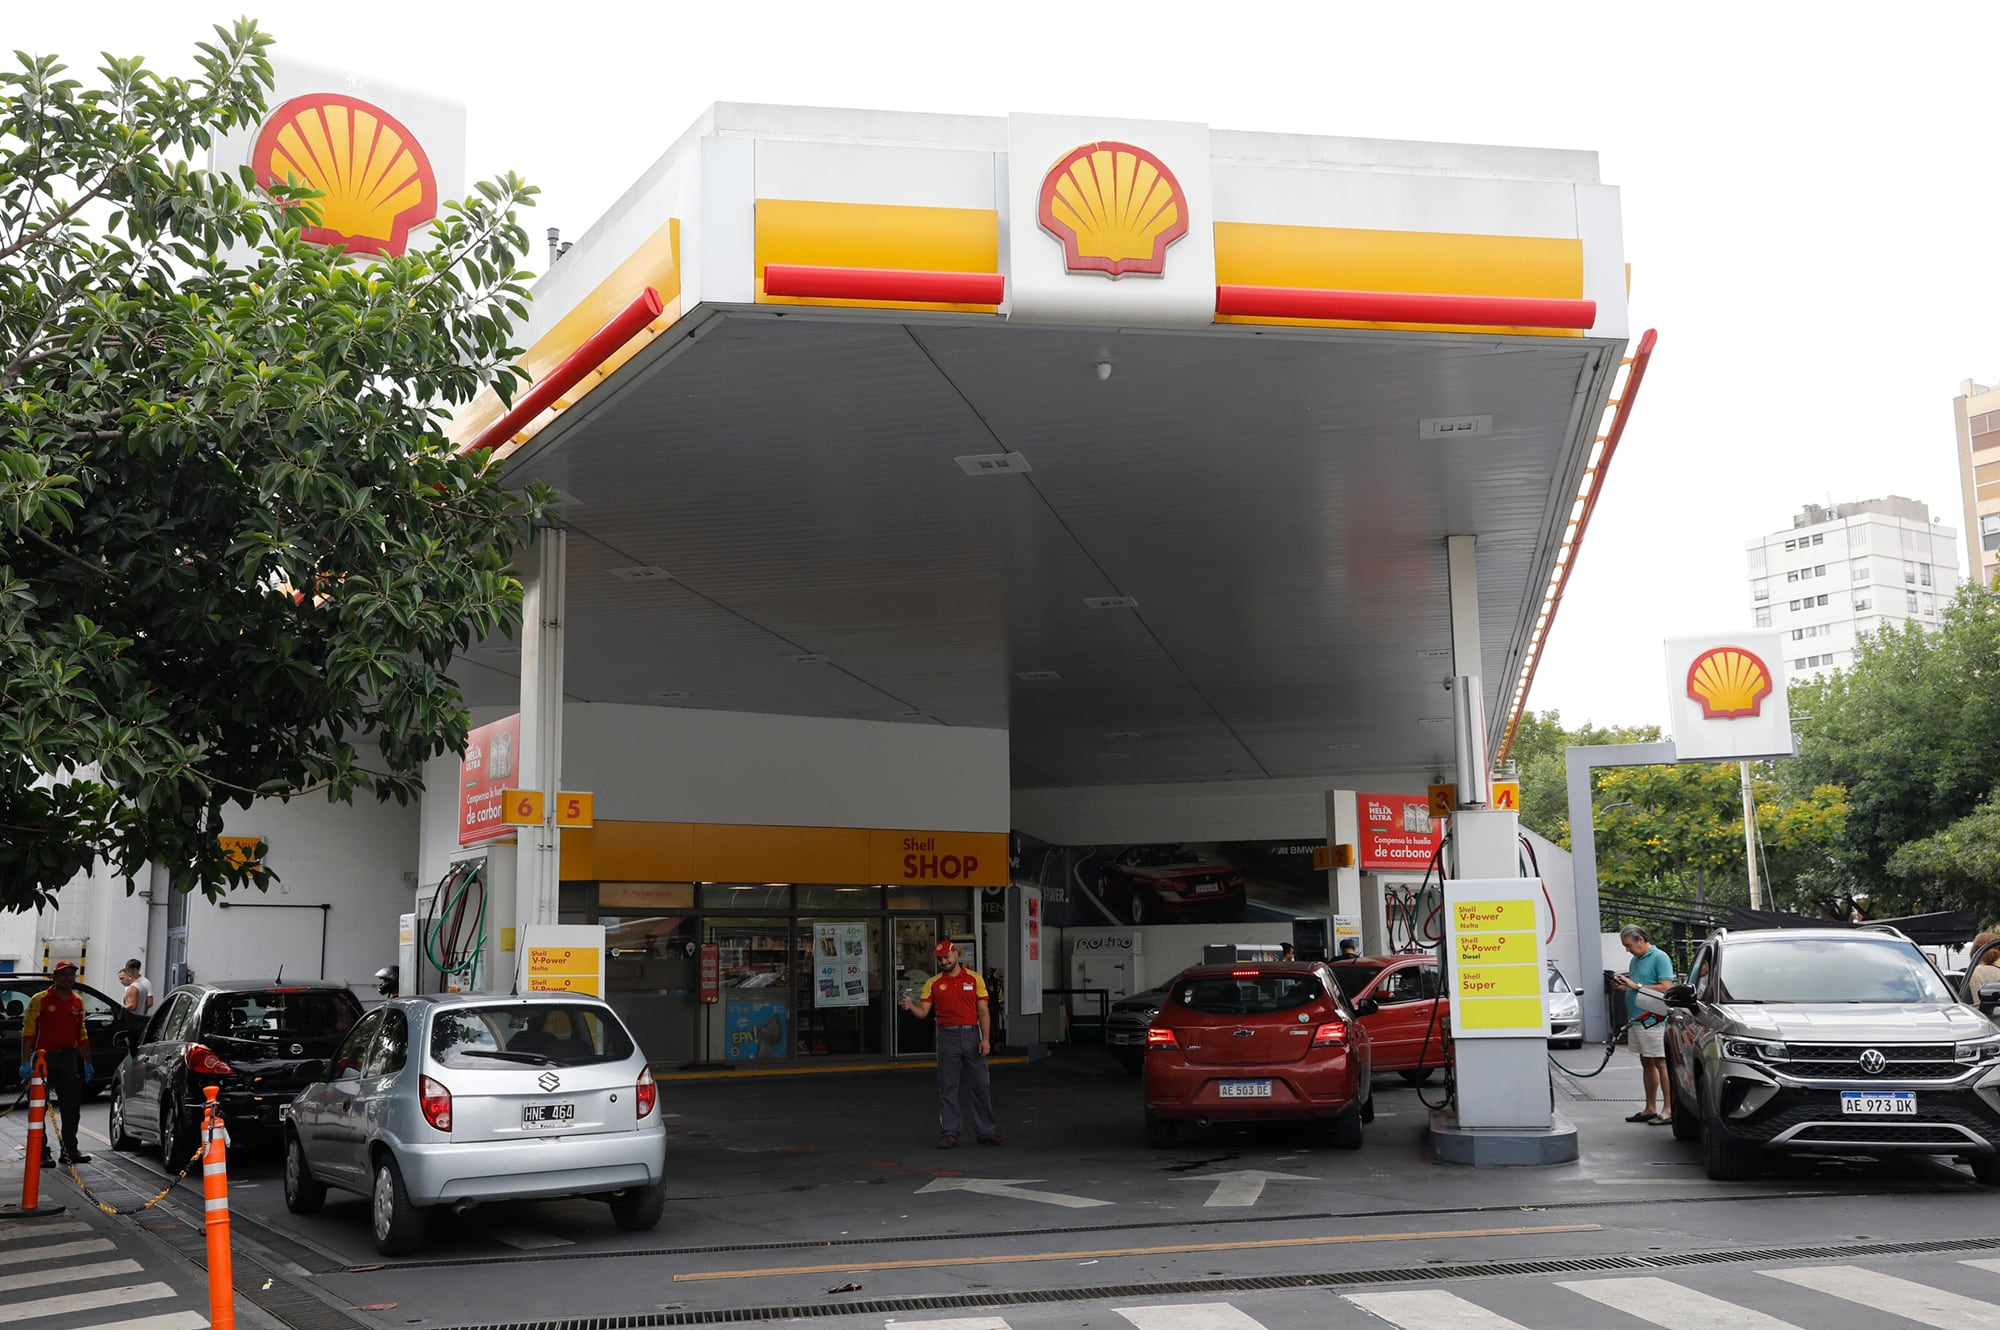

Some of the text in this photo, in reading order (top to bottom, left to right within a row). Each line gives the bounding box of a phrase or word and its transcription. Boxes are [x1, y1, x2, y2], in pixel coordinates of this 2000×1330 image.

[465, 758, 481, 771] ULTRA
[466, 791, 489, 805] Compensa
[489, 787, 494, 798] la
[1436, 792, 1449, 810] 3
[1497, 790, 1513, 808] 4
[517, 798, 533, 817] 6
[566, 800, 580, 819] 5
[1369, 806, 1392, 815] HELIX
[466, 806, 476, 824] de
[903, 838, 935, 851] Shell
[1374, 836, 1431, 845] Compensa la huella
[1290, 846, 1314, 855] BMW
[1375, 845, 1388, 857] de
[1318, 852, 1323, 864] 1
[1336, 851, 1343, 863] 2
[903, 854, 978, 879] SHOP
[1460, 913, 1500, 921] V-Power
[1462, 944, 1501, 952] V-Power
[1462, 953, 1481, 961] Diesel
[1463, 981, 1495, 992] Super
[732, 1025, 759, 1044] EPA!
[1222, 1086, 1268, 1096] AE 503 DE
[1846, 1100, 1912, 1112] AE 973 DK
[525, 1105, 573, 1121] HNE 464
